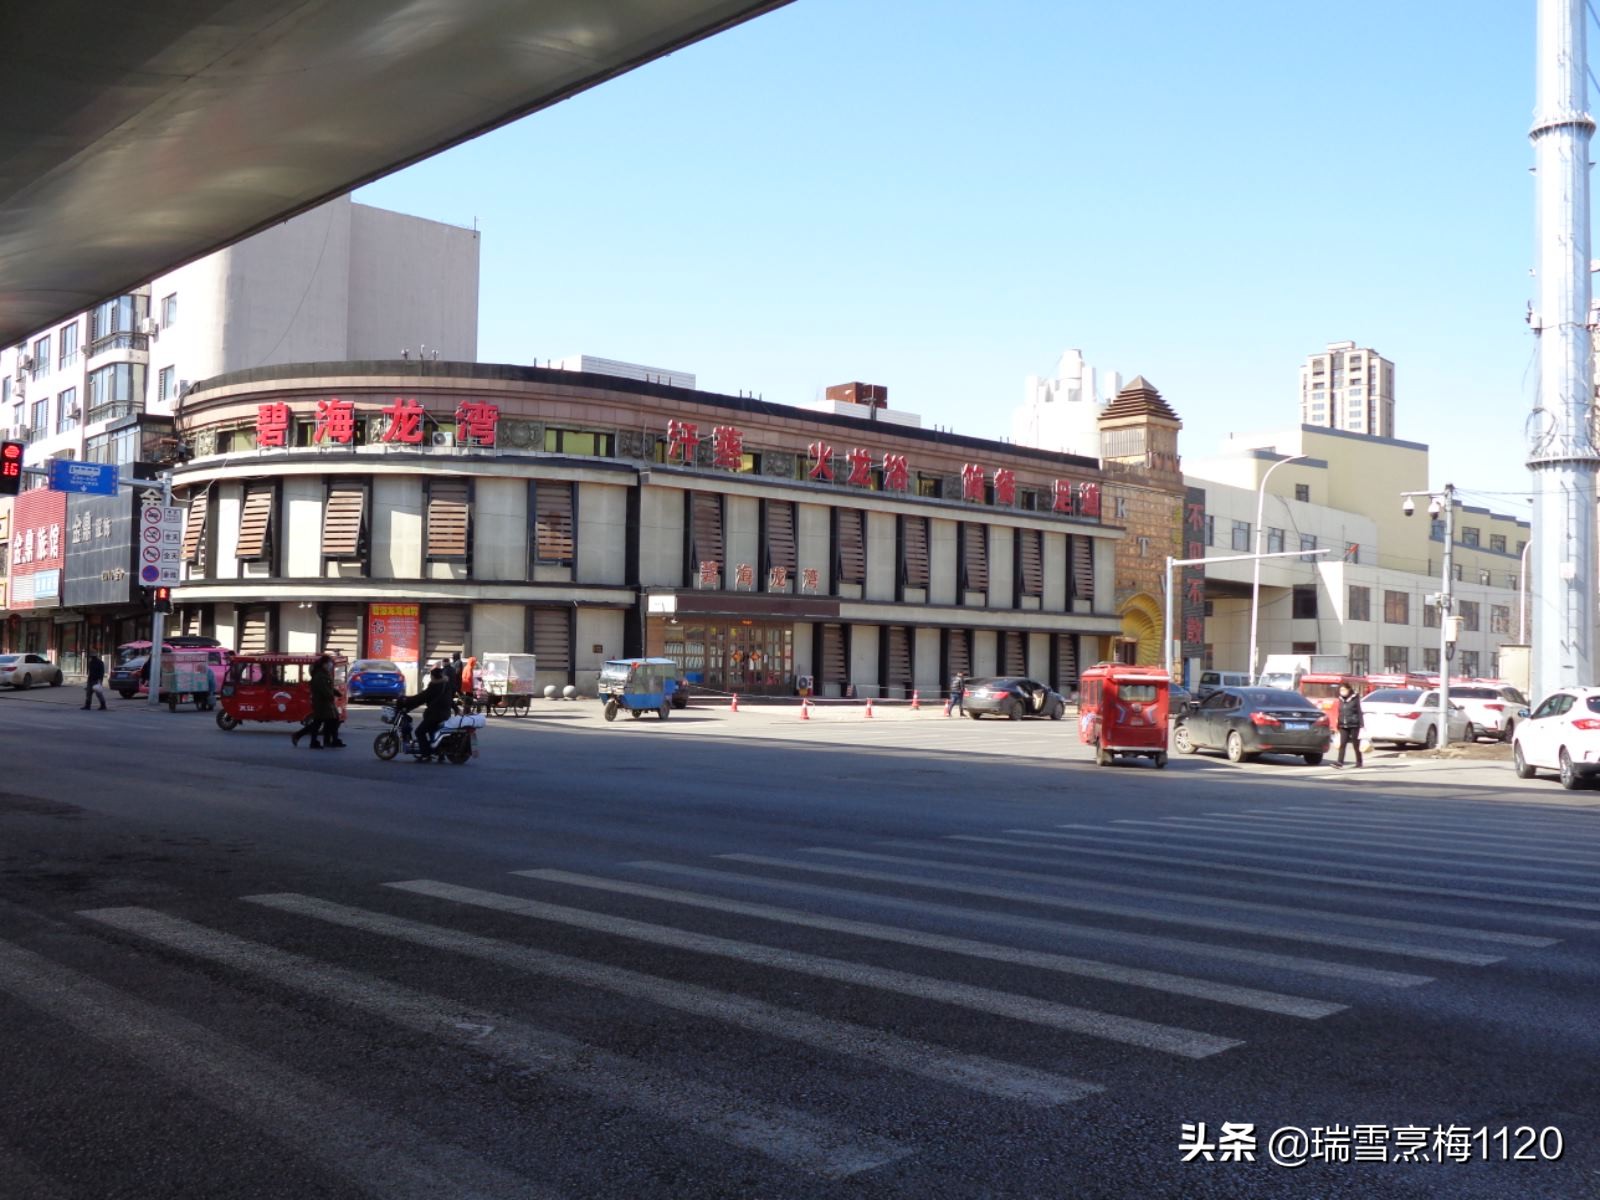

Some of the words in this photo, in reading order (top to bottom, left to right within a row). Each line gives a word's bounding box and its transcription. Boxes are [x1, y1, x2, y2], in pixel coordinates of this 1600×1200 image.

[256, 397, 499, 446] 碧海龙湾
[668, 419, 743, 471] 汗蒸
[808, 441, 908, 489] 火龙浴
[700, 560, 819, 588] 碧海龙湾
